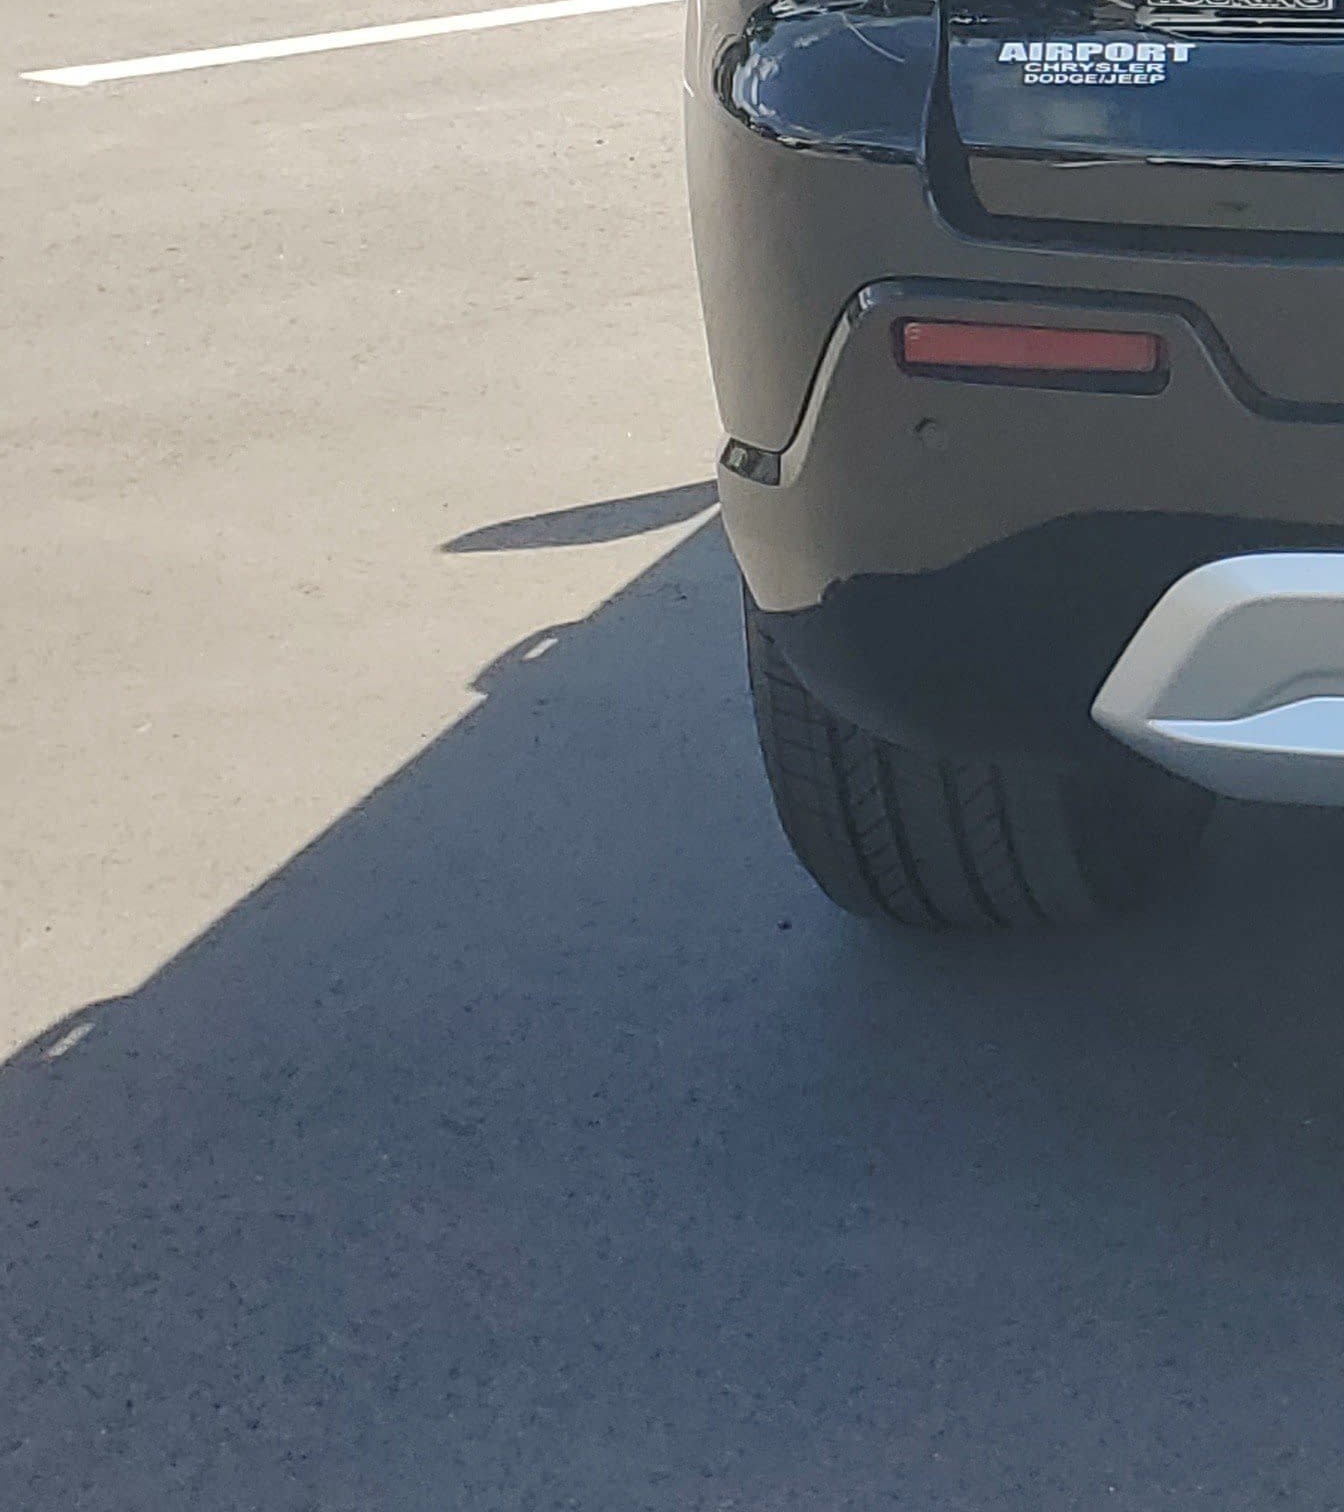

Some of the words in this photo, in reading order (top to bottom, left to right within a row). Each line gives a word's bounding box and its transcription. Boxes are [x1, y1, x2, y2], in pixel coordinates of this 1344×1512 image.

[998, 41, 1197, 63] AIRPORT
[1024, 63, 1166, 73] CHRYSLER
[1023, 73, 1167, 85] DODGE/JEEP
